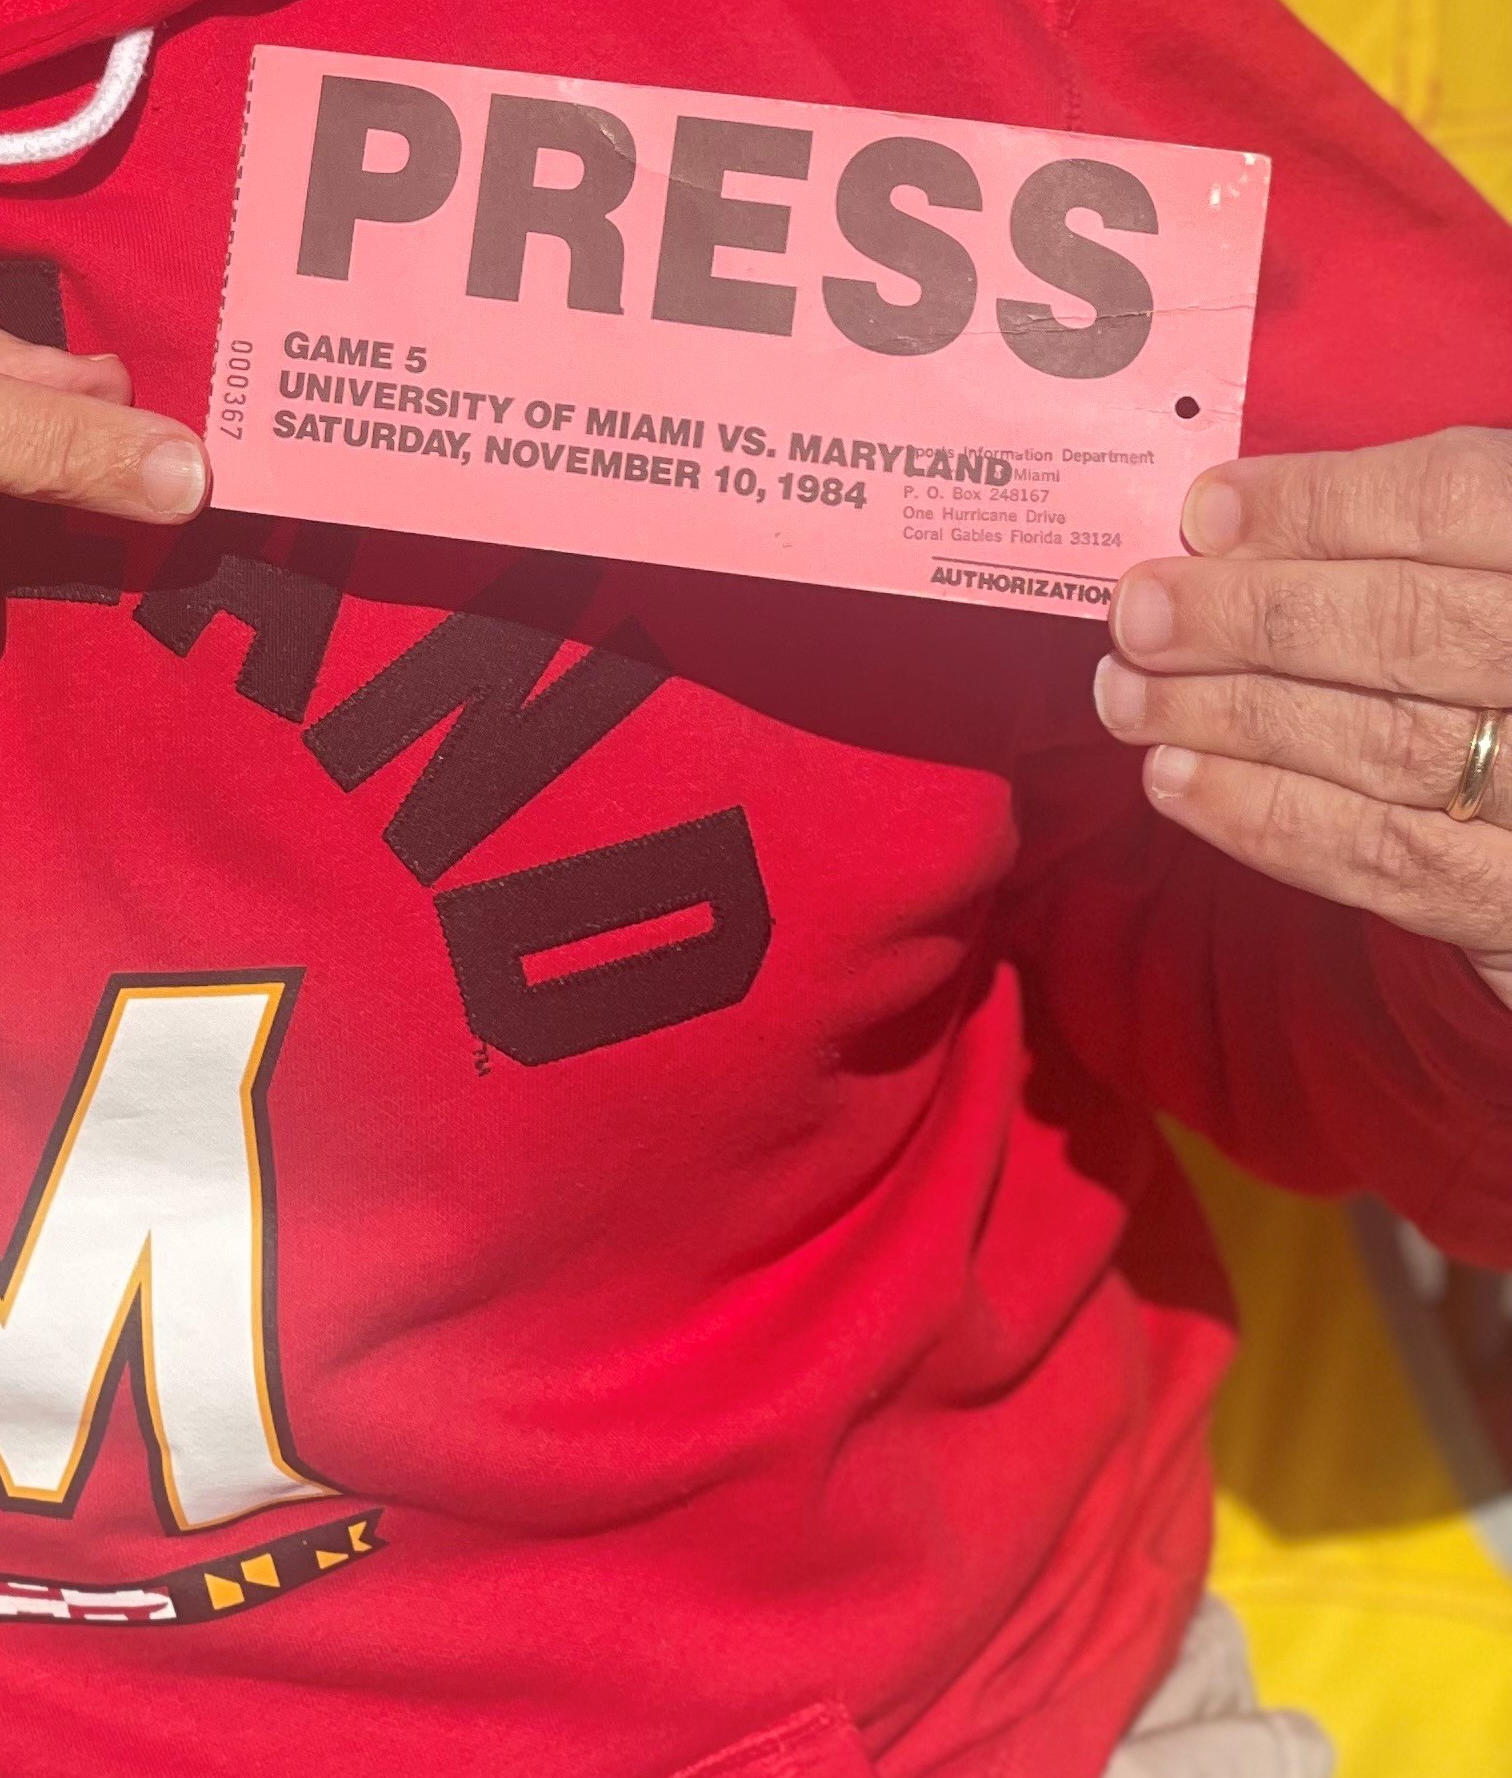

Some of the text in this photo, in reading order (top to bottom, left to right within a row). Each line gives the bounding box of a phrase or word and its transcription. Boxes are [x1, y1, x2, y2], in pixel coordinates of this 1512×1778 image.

[296, 75, 1159, 379] PRESS
[284, 331, 427, 374] GAME 5
[220, 340, 253, 440] 000367
[279, 370, 515, 424] UNIVERSITY
[524, 400, 575, 431] OF
[585, 406, 705, 448] MIAMI
[718, 423, 776, 458] VS.
[788, 432, 1013, 486] MARYLAND
[273, 410, 471, 466] SATURDAY,
[484, 435, 701, 489] NOVEMBER
[715, 465, 766, 503] 10,
[777, 472, 867, 509] 1984
[1062, 448, 1155, 465] Department
[1014, 468, 1060, 483] Miami
[903, 485, 1049, 503] P. O. Box 248167
[903, 506, 1066, 525] One Hurricane Drive
[903, 526, 1122, 548] Coral Gables Florida 33124
